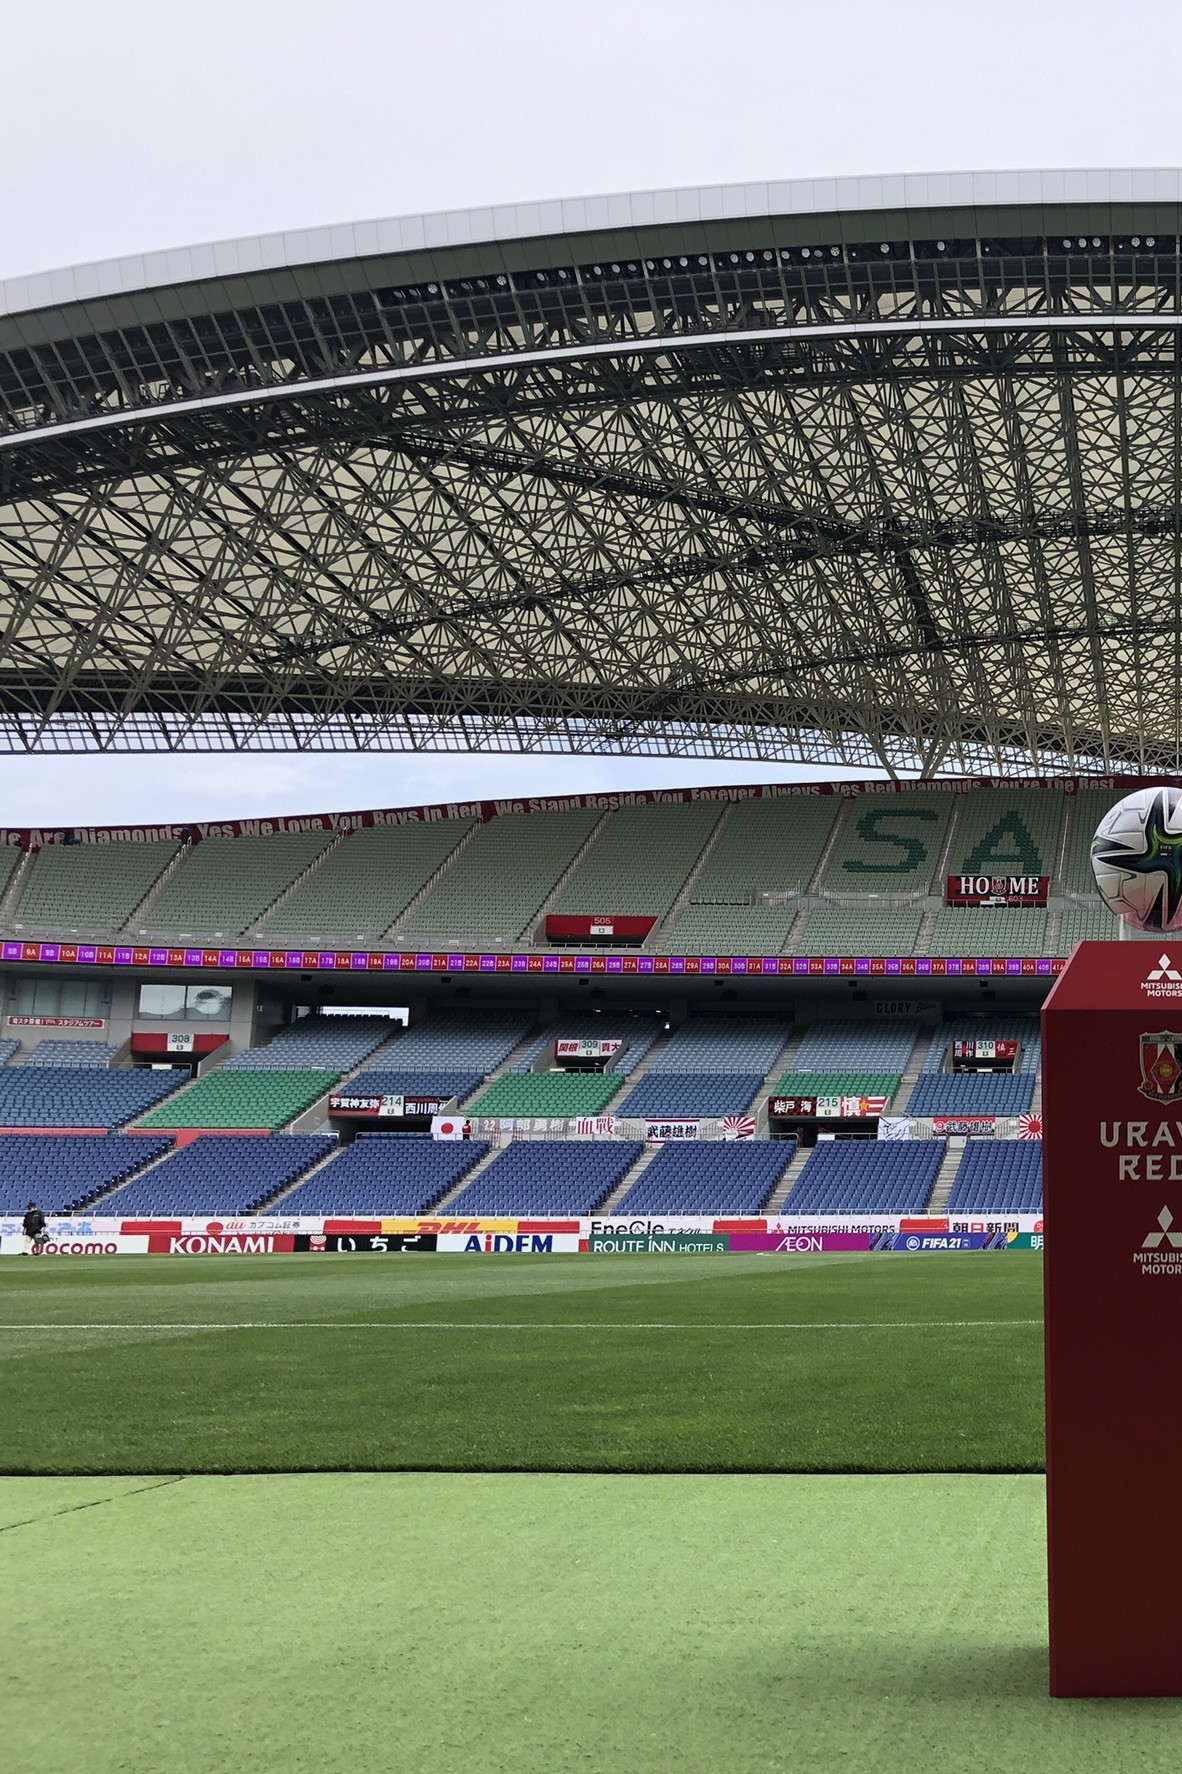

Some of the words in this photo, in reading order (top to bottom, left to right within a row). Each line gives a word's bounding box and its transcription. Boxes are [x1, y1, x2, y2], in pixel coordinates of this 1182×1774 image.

[74, 826, 183, 844] Diamonds
[197, 823, 234, 839] Yes
[239, 820, 273, 837] We
[278, 817, 323, 834] Love
[328, 813, 362, 830] You
[423, 806, 442, 822] In
[447, 802, 482, 819] Red
[494, 801, 523, 816] We
[530, 797, 581, 813] Stand
[831, 782, 858, 797] Yes
[1046, 778, 1075, 792] The
[594, 916, 611, 924] 505
[876, 1002, 911, 1013] GLORY
[172, 1034, 190, 1043] 308
[581, 1040, 598, 1049] 309
[382, 1097, 402, 1106] 214
[818, 1097, 838, 1107] 215
[417, 1222, 487, 1234] DHL
[788, 1225, 848, 1234] MITSUBISHI
[850, 1225, 896, 1234] MOTORS
[169, 1236, 274, 1254] KONAMI
[594, 1240, 645, 1252] ROUTE
[679, 1242, 724, 1252] HOTELS
[922, 1238, 947, 1249] FIFA
[949, 1238, 962, 1249] 21
